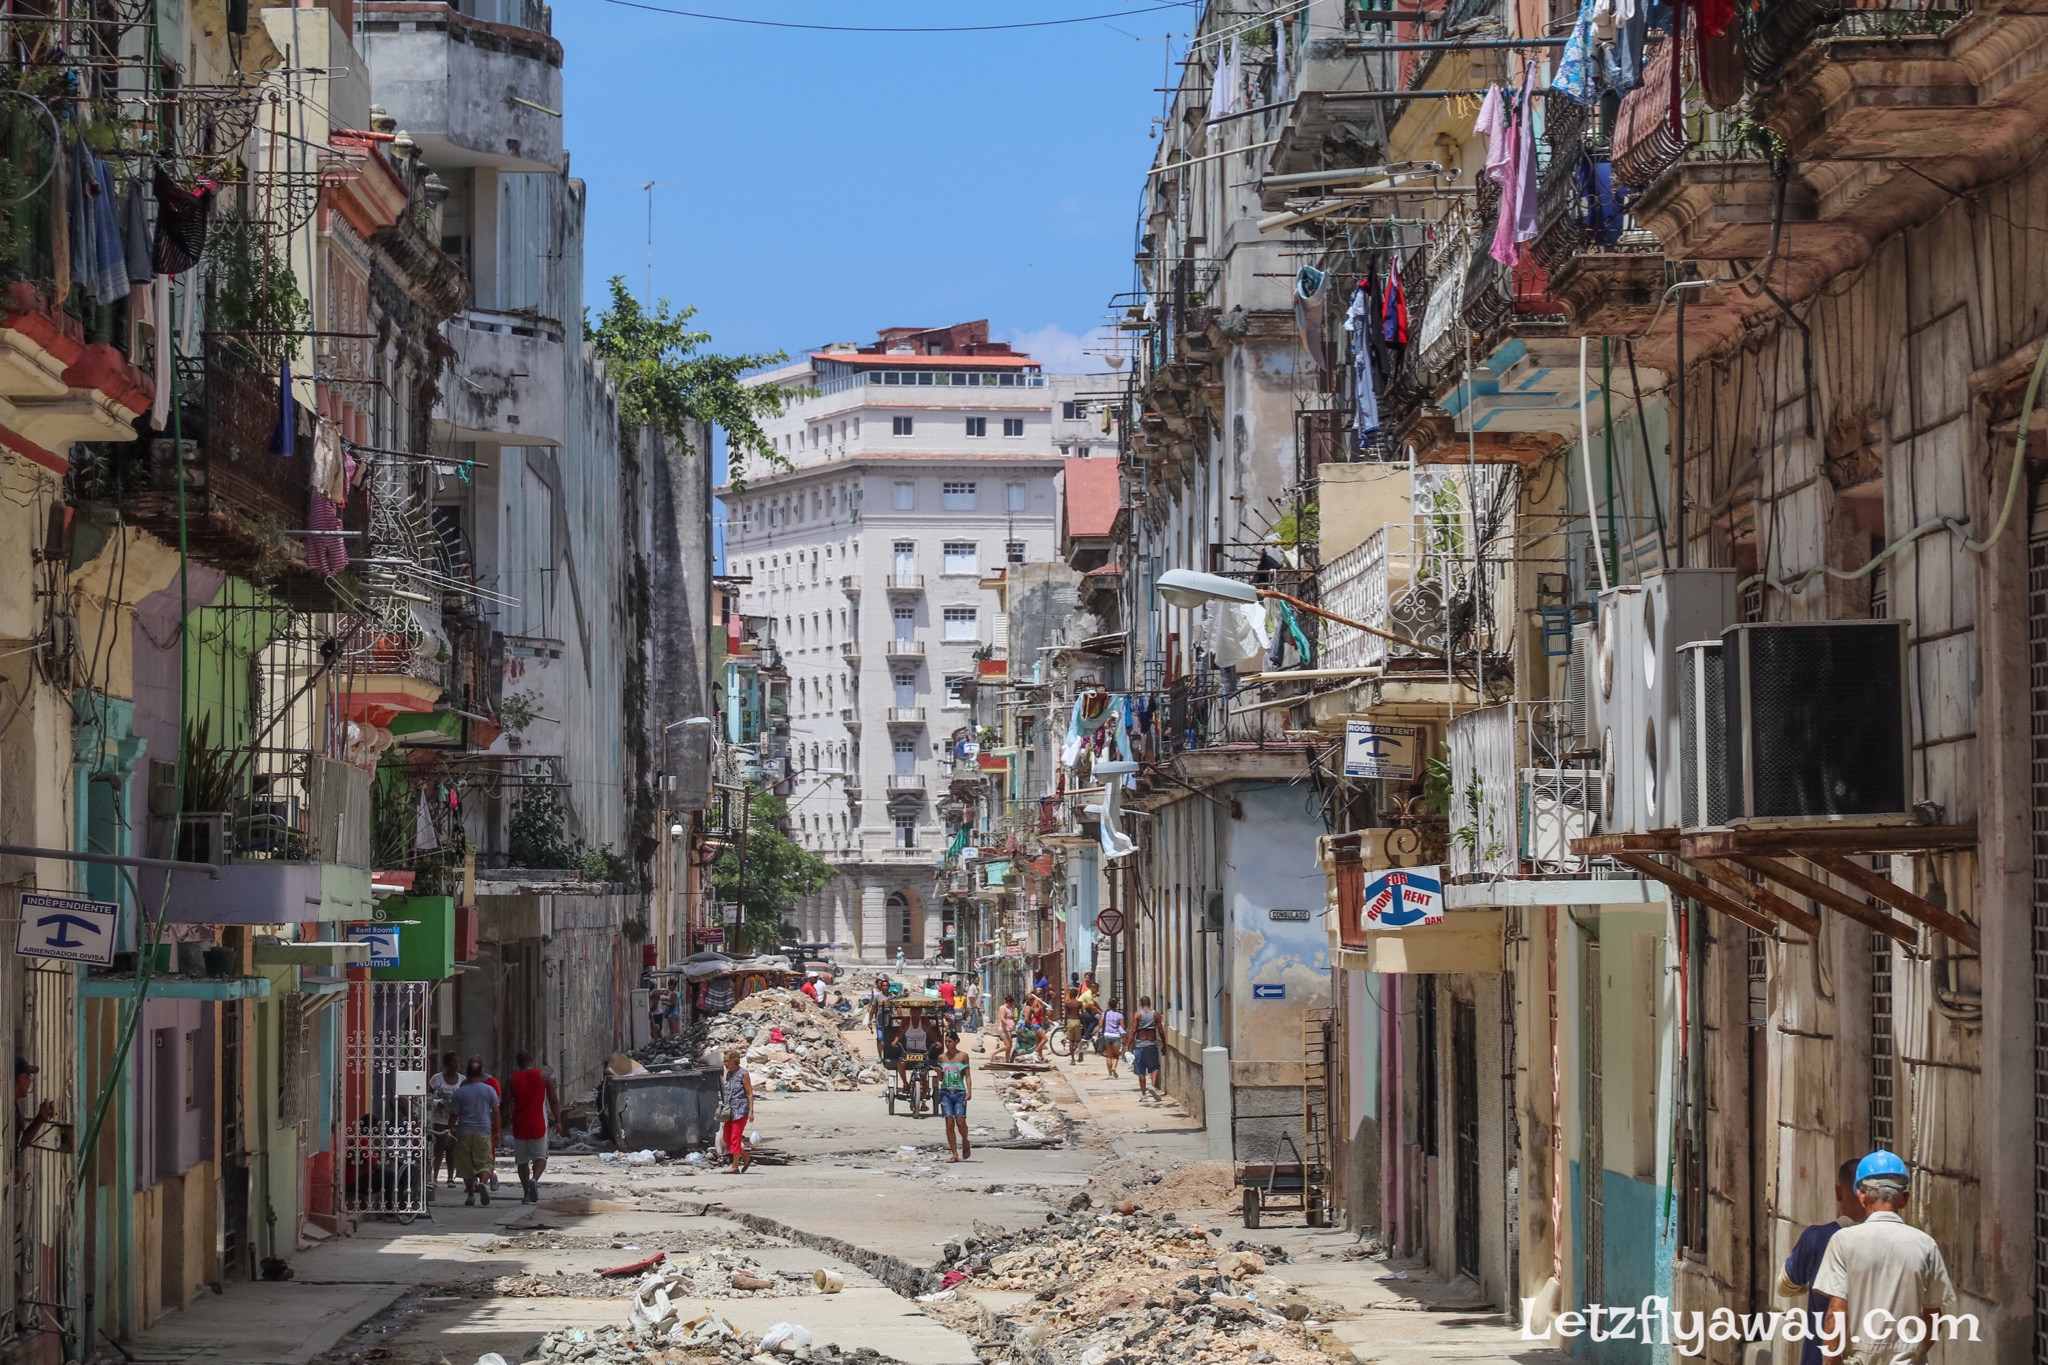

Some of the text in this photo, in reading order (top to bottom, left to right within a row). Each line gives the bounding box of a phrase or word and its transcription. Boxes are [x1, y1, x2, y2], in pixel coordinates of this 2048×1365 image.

[1349, 725, 1373, 733] ROOM
[1374, 726, 1391, 734] FOR
[1385, 873, 1408, 886] FOR
[26, 896, 112, 914] INDEPENDIENTE
[1367, 889, 1393, 921] ROOM
[1403, 889, 1432, 906] RENT
[1272, 911, 1307, 919] CONSULADO
[23, 946, 105, 961] ARRENDADOR DIVISA
